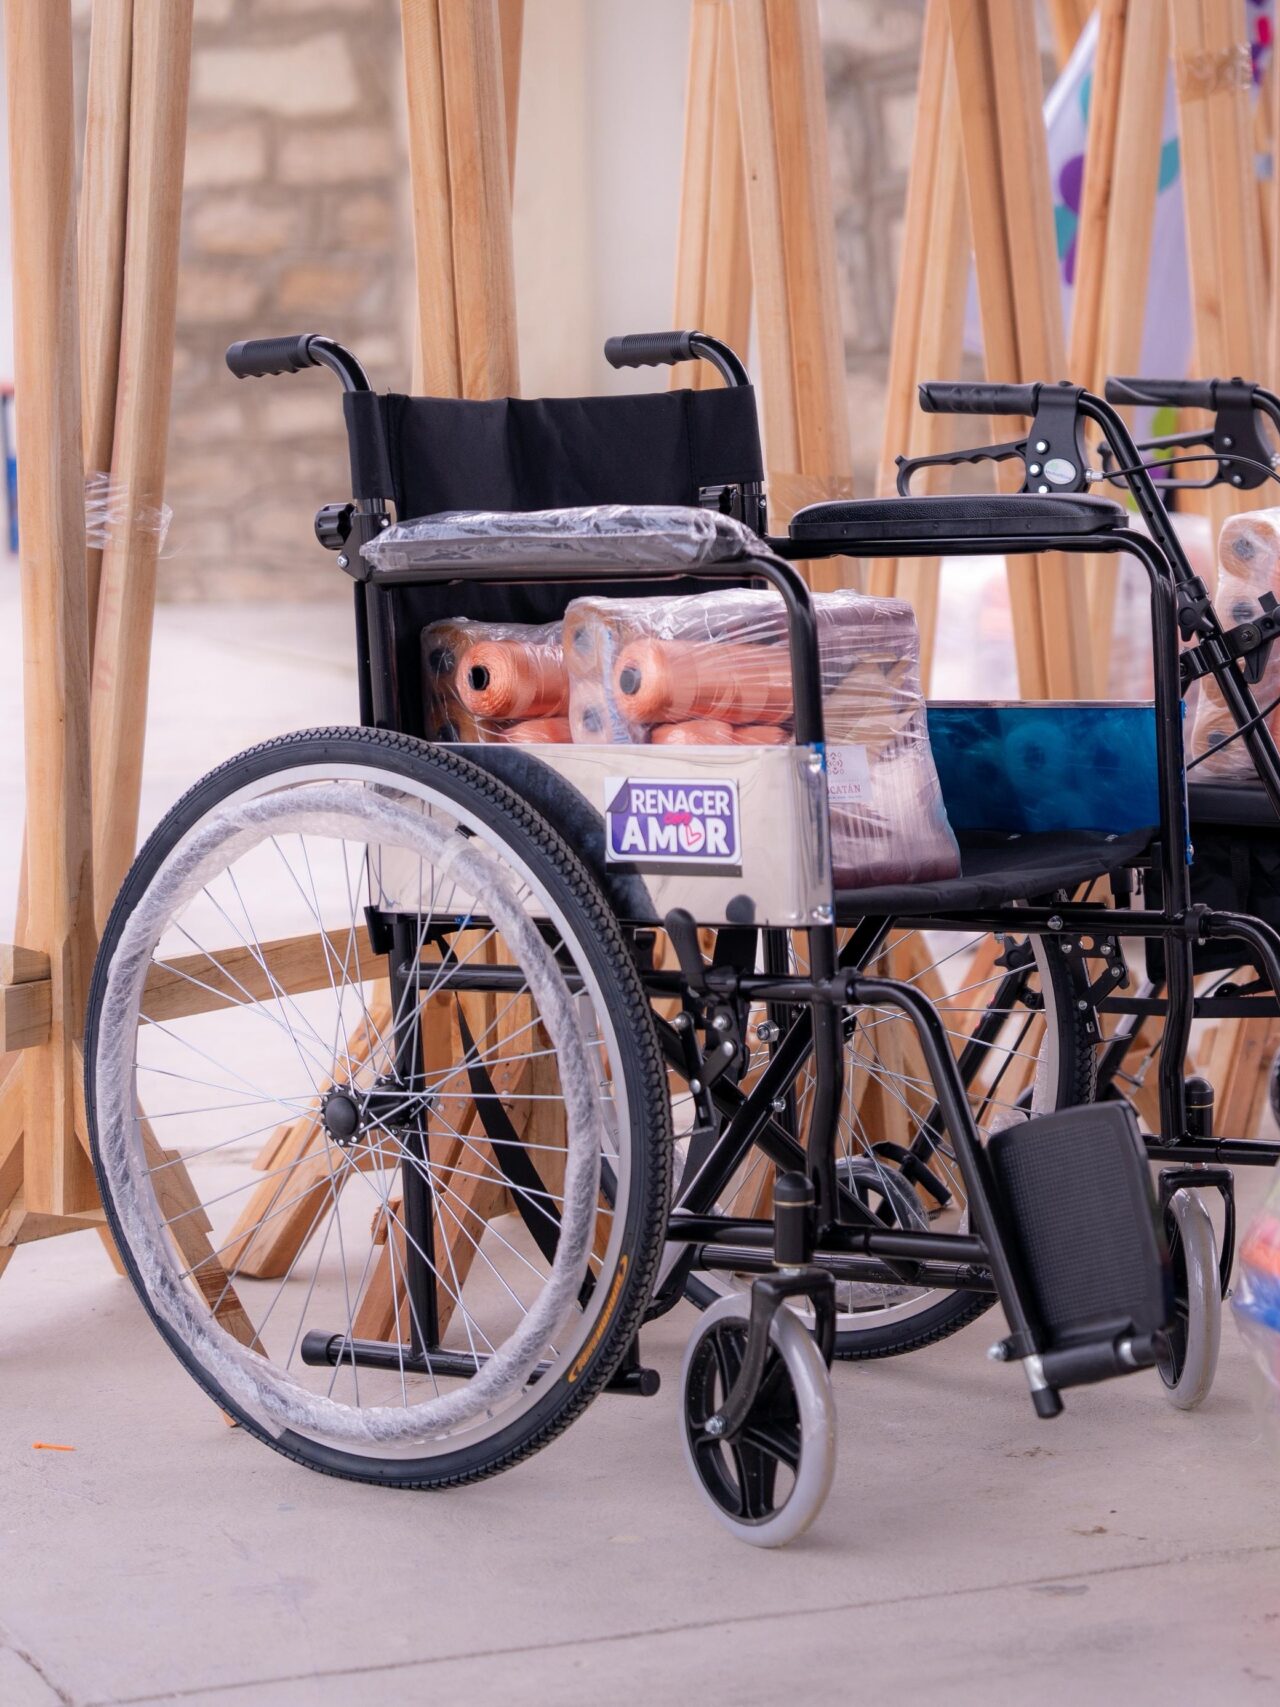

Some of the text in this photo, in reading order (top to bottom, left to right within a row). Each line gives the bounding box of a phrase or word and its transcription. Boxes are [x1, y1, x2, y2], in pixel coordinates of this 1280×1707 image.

[630, 788, 731, 816] RENACER
[826, 784, 861, 795] CATÁN
[620, 816, 731, 854] AMOR
